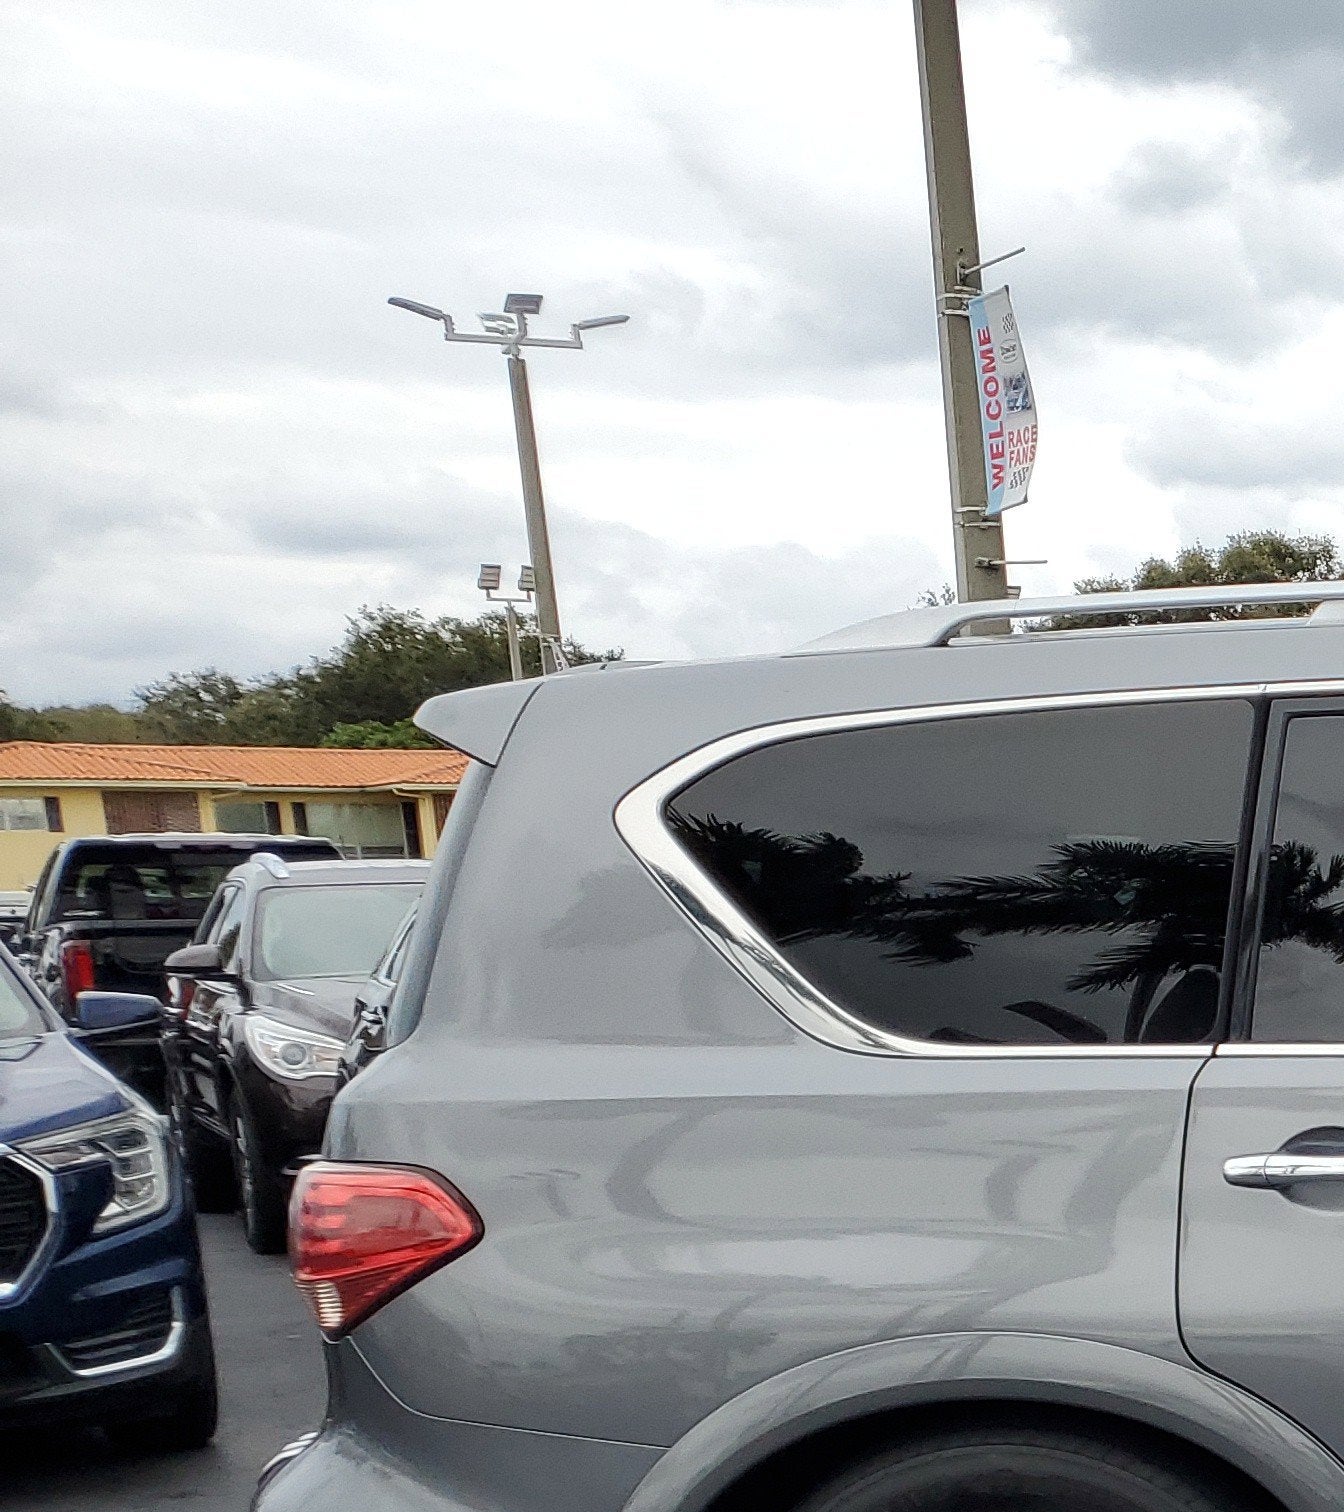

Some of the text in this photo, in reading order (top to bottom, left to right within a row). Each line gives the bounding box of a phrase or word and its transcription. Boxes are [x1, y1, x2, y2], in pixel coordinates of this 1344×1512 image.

[977, 326, 1005, 490] WELCOME
[1008, 424, 1037, 449] RACE
[1009, 446, 1036, 469] FANS
